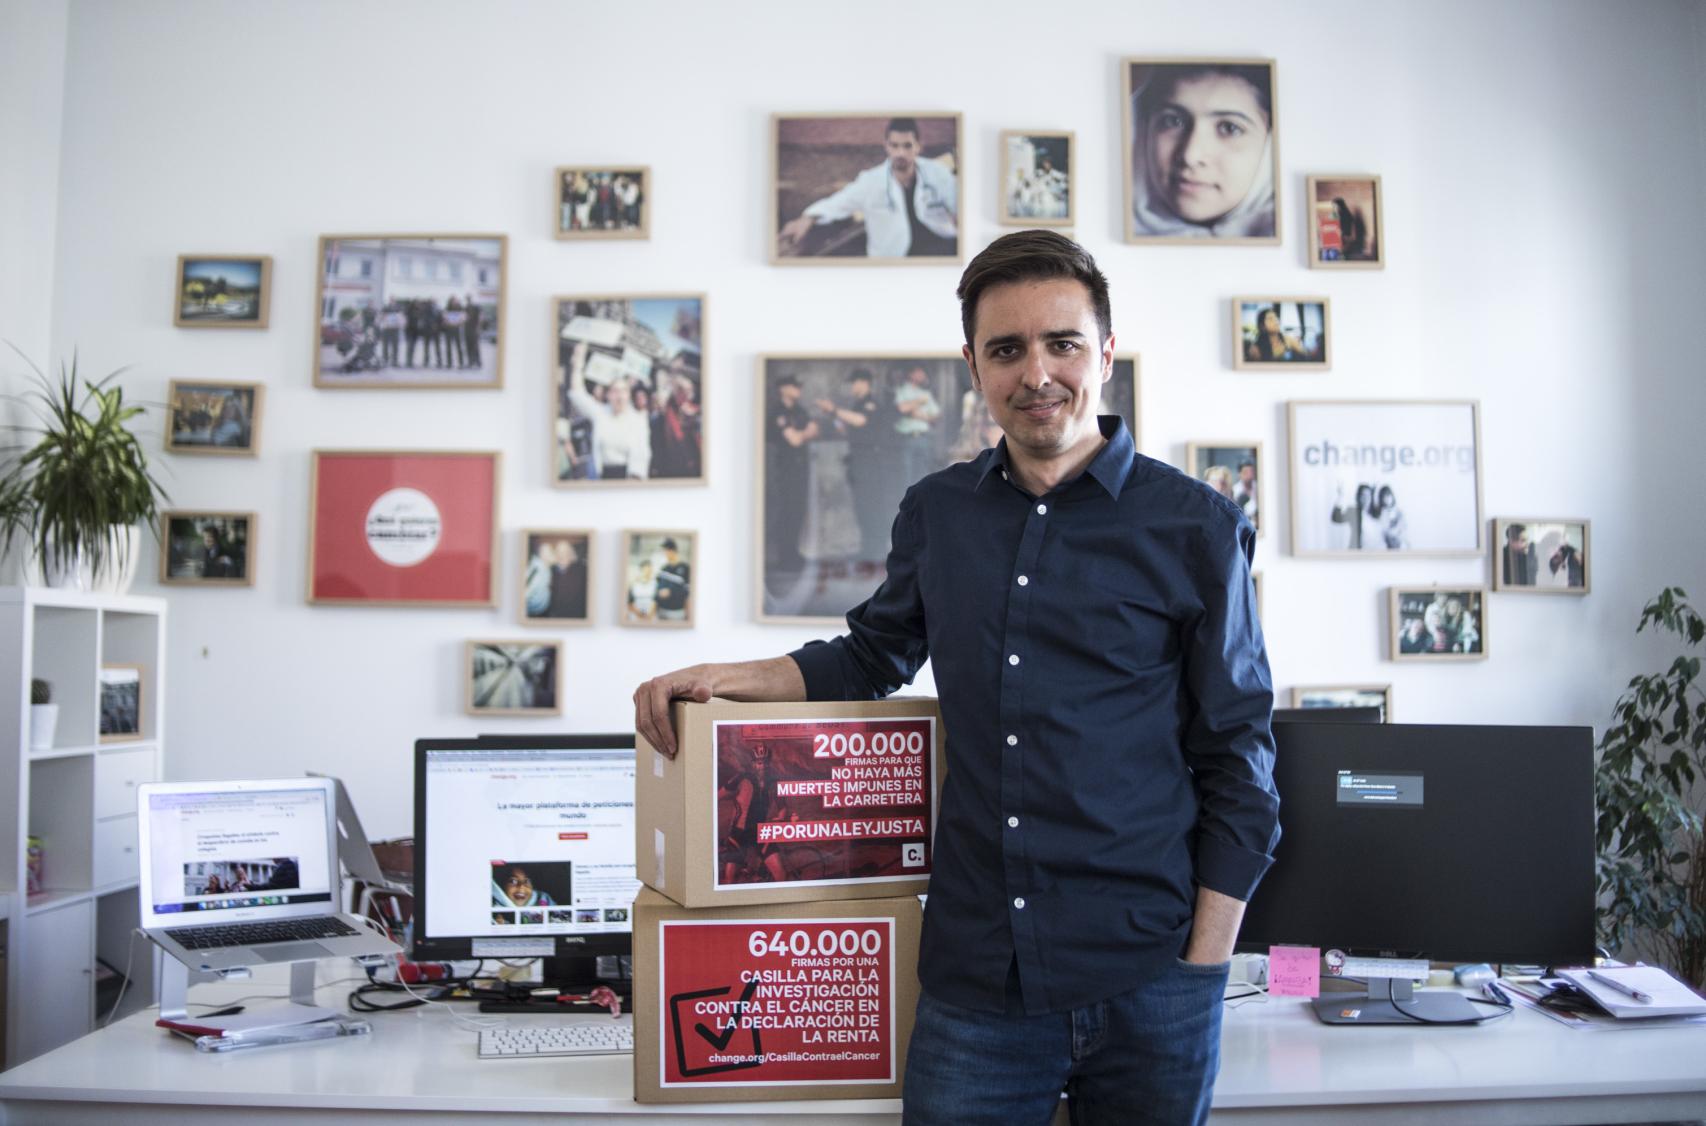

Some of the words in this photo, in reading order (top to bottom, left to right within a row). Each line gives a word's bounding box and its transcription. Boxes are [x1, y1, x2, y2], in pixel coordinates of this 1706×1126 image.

[1304, 440, 1475, 473] change.org
[814, 731, 924, 757] 200.000
[845, 757, 878, 766] FIRMAS
[879, 756, 903, 765] PARA
[904, 756, 922, 765] QUE
[832, 768, 851, 780] NO
[855, 767, 890, 779] HAYA
[893, 763, 922, 778] MÁS
[777, 781, 840, 795] MUERTES
[844, 780, 901, 793] IMPUNES
[905, 779, 922, 791] EN
[823, 795, 842, 808] LA
[844, 793, 923, 806] CARRETERA
[760, 819, 924, 840] #PORUNALEYJUSTA
[748, 929, 882, 957] 640.000
[791, 958, 830, 967] FIRMAS
[832, 957, 854, 967] POR
[856, 957, 879, 966] UNA
[740, 970, 806, 983] CASILLA
[811, 969, 854, 982] PARA
[858, 969, 879, 981] LA
[756, 981, 879, 998] INVESTIGACIÓN
[695, 1001, 762, 1014] CONTRA
[766, 1001, 785, 1013] EL
[789, 997, 854, 1013] CÁNCER
[859, 999, 879, 1012] EN
[716, 1016, 737, 1029] LA
[742, 1012, 855, 1029] DECLARACIÓN
[859, 1015, 879, 1027] DE
[802, 1030, 823, 1043] LA
[827, 1030, 879, 1042] RENTA
[708, 1051, 880, 1065] change.org/CasillaContraelCancer
